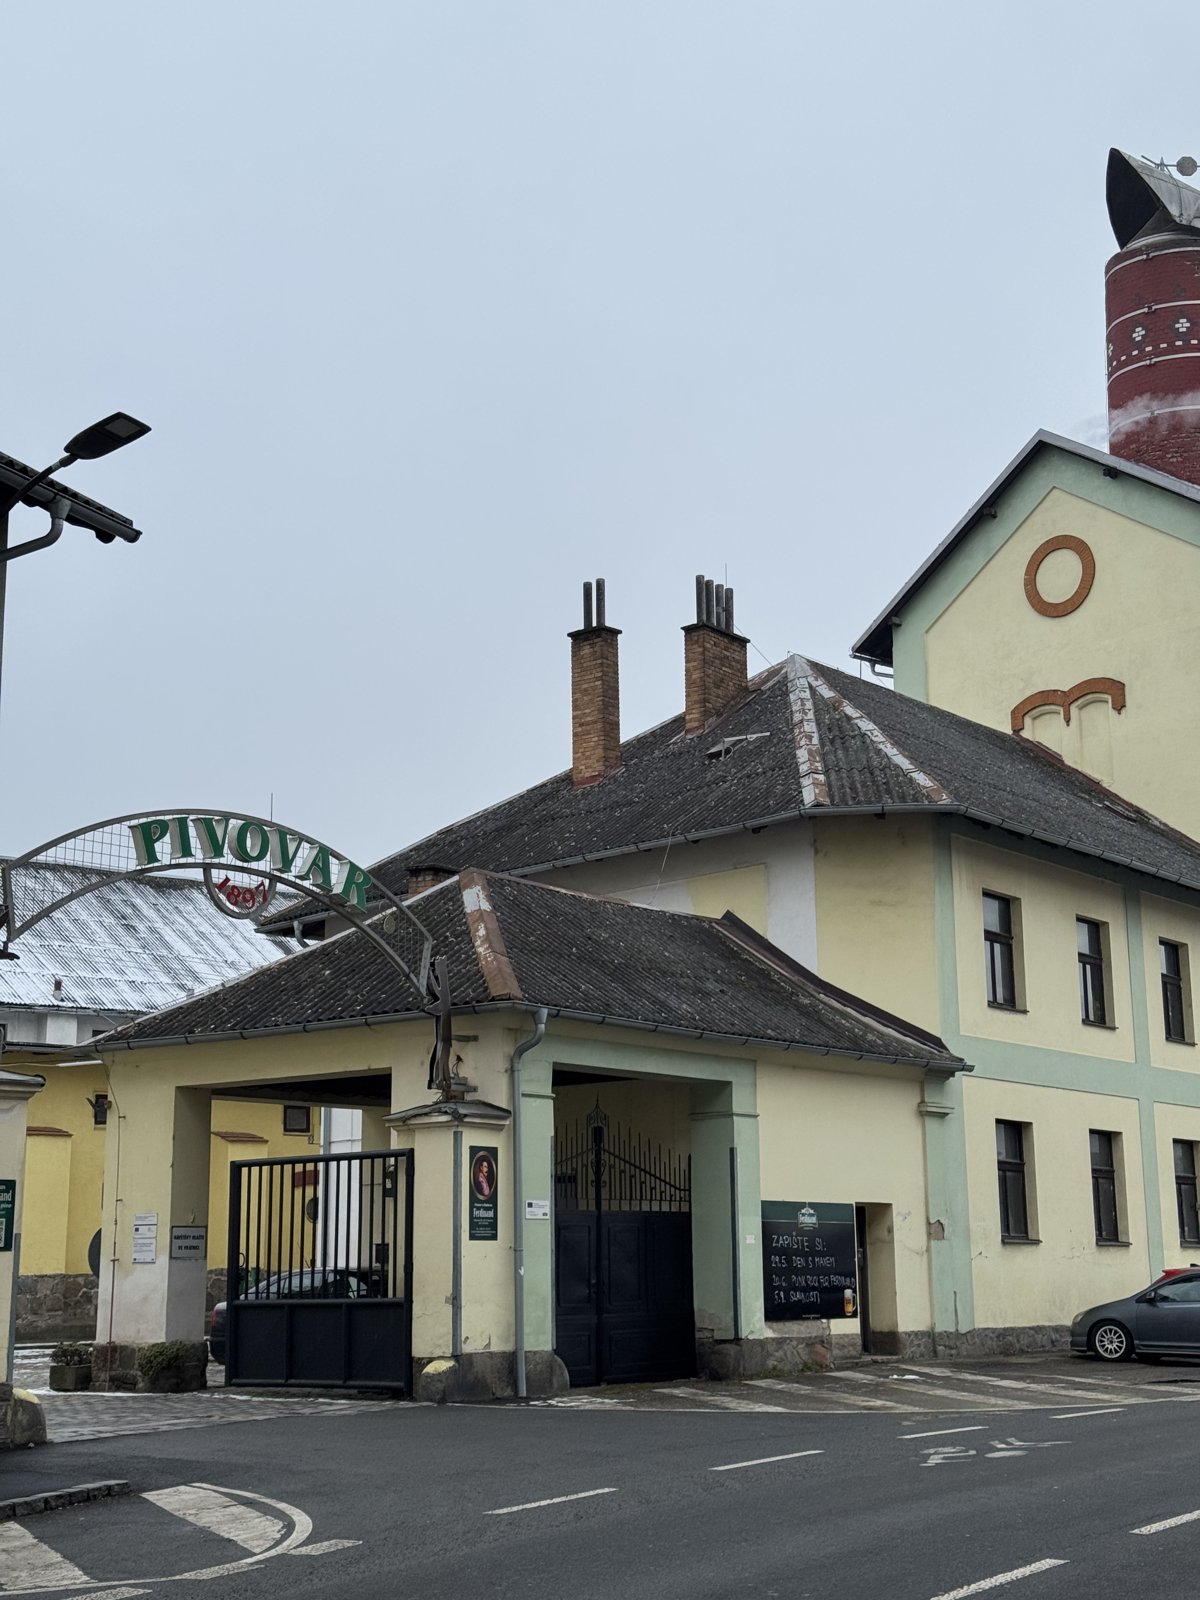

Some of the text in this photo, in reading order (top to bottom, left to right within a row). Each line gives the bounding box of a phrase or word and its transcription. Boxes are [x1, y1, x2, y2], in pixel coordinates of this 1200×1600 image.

[128, 816, 372, 913] PIVOVAR
[215, 875, 268, 910] 1897
[473, 1208, 494, 1217] Ferdinand
[772, 1231, 827, 1251] ZAPIŠTE SI:
[792, 1256, 806, 1267] DEN
[808, 1256, 813, 1268] S
[791, 1274, 806, 1287] PUNK
[819, 1275, 830, 1288] FOR
[790, 1291, 820, 1304] SLAVNOSTI
